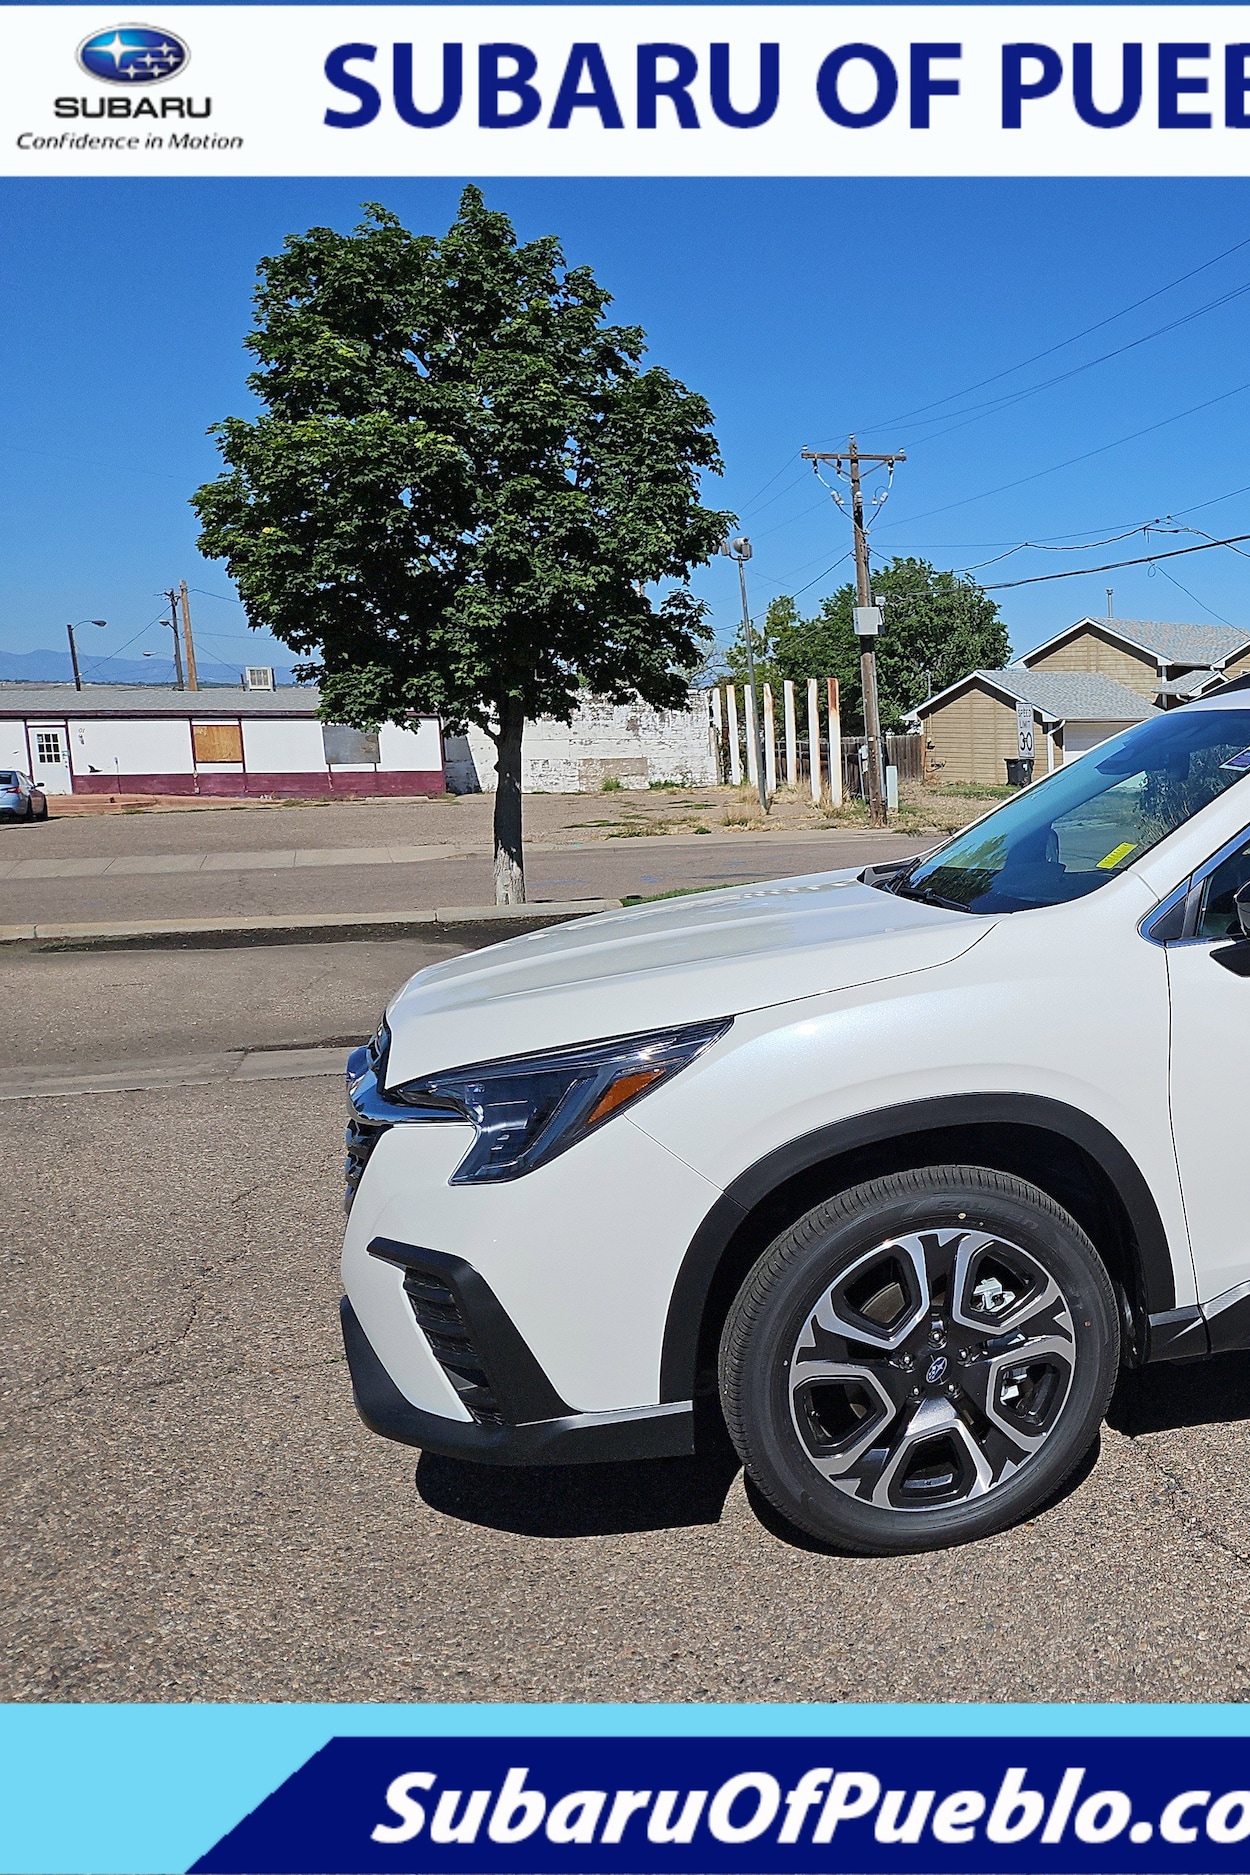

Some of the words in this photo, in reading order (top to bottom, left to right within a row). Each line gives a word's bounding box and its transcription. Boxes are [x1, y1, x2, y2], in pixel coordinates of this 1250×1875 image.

[1018, 708, 1031, 717] SPEED
[1019, 720, 1031, 728] LIMIT
[1019, 731, 1033, 751] 30
